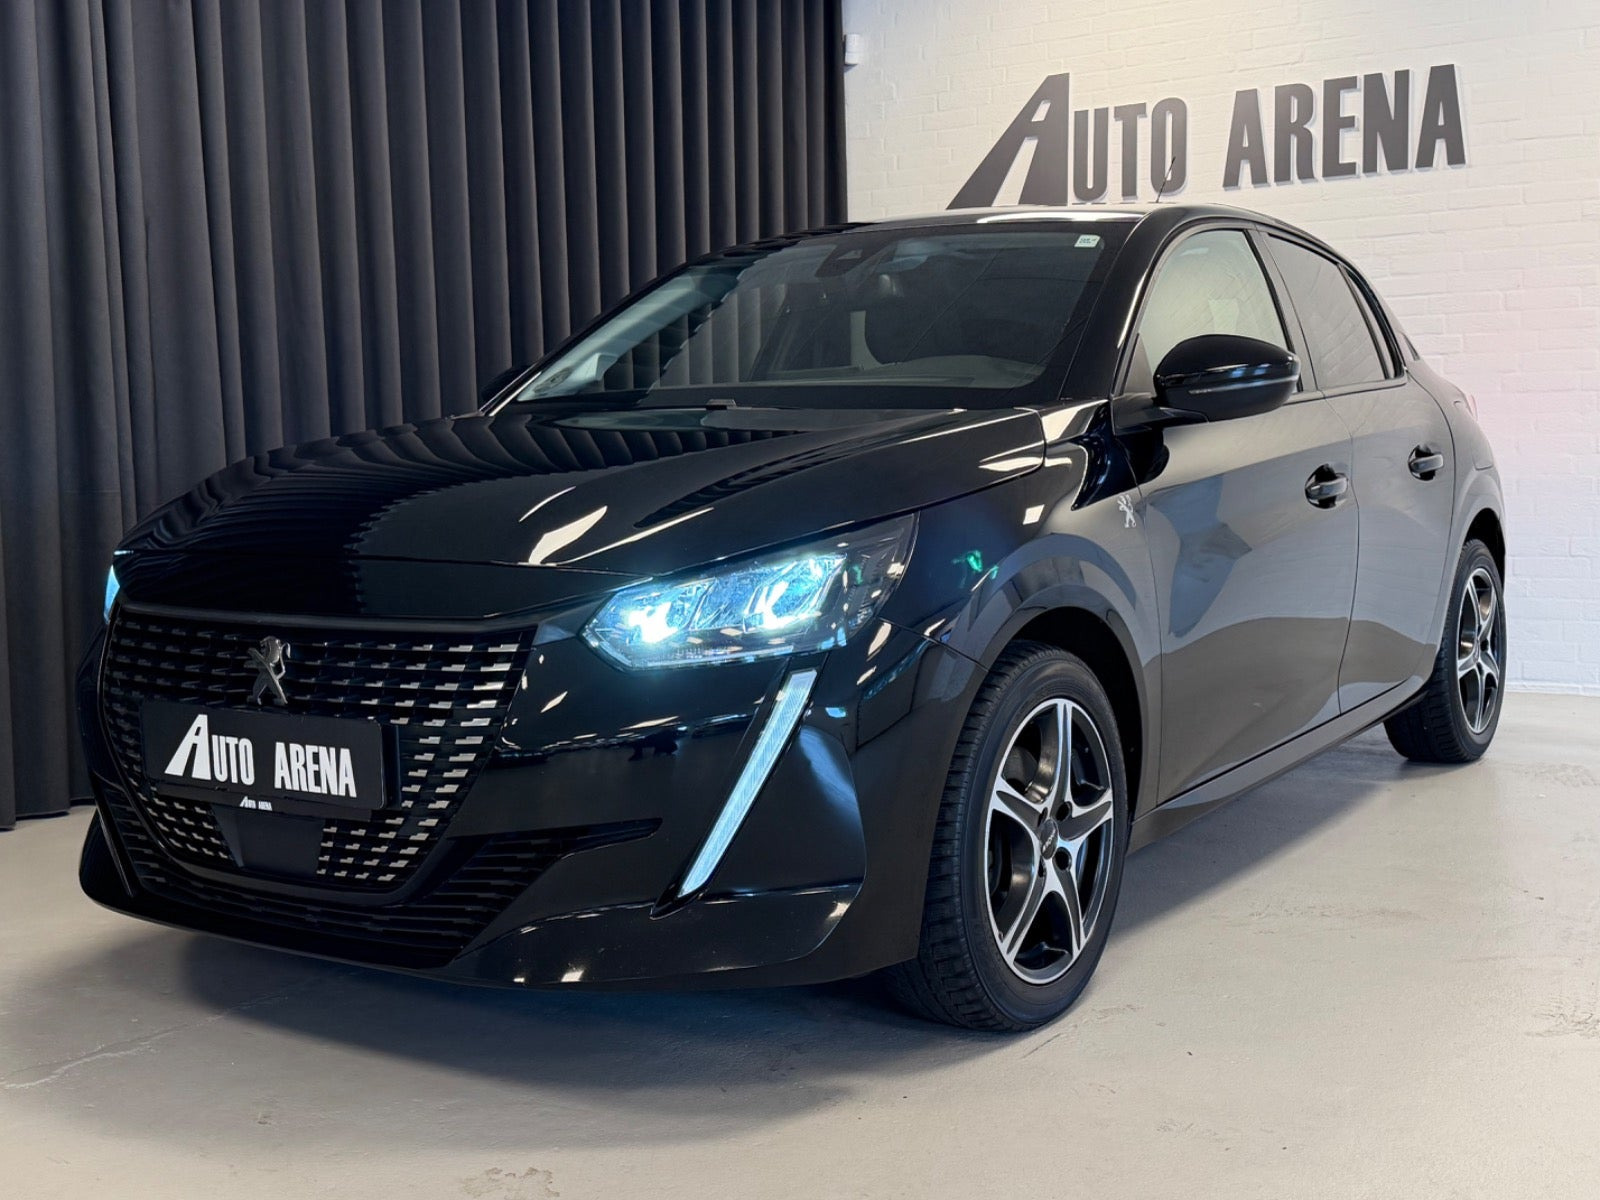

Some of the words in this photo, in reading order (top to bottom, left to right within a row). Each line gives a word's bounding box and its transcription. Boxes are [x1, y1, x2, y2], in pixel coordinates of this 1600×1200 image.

[946, 72, 1188, 210] AUTO
[1222, 64, 1466, 189] ARENA
[164, 713, 255, 786] AUTO
[274, 741, 357, 798] ARENA
